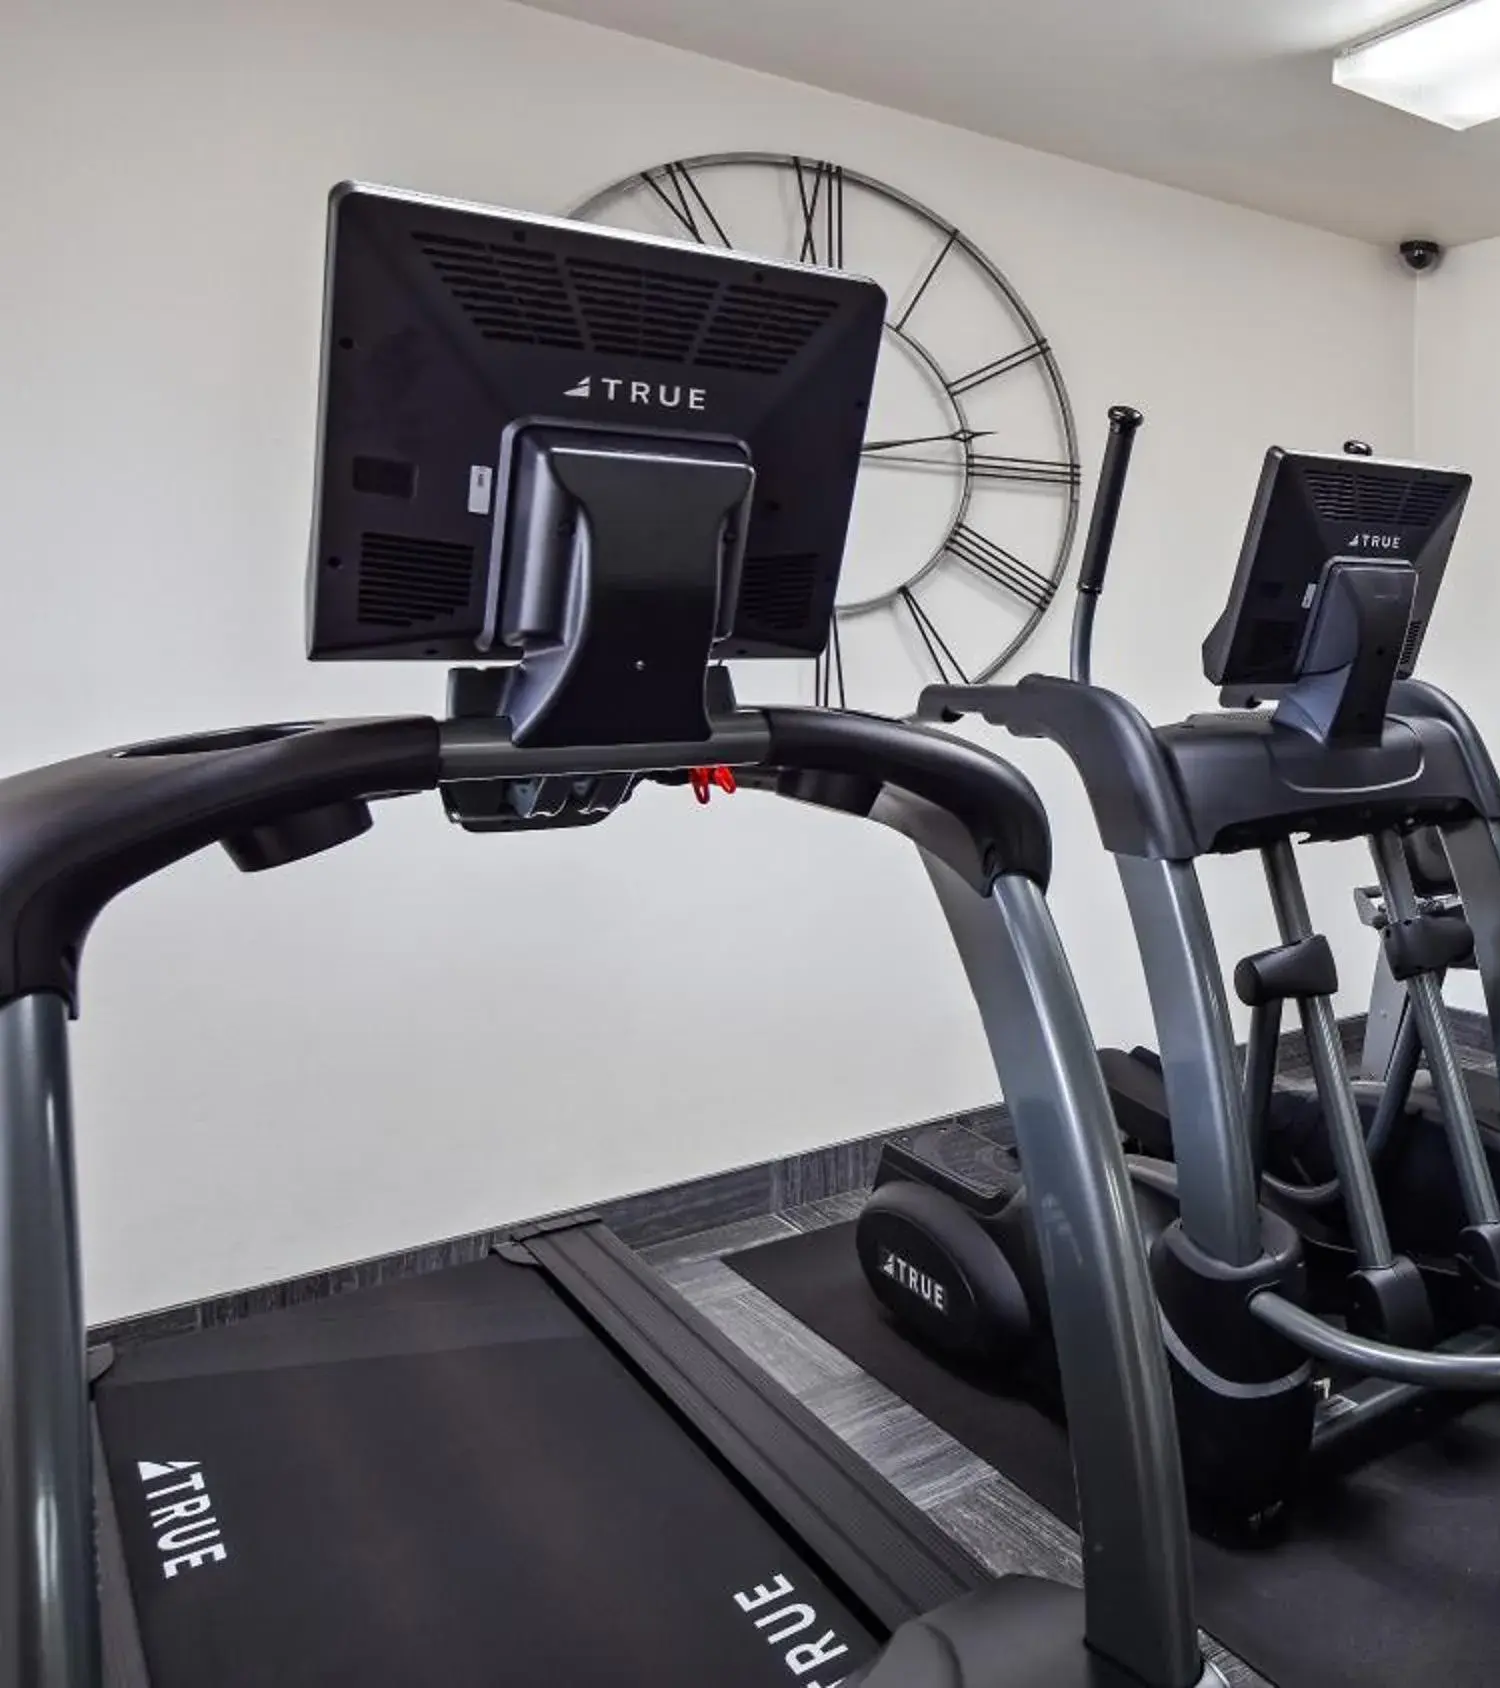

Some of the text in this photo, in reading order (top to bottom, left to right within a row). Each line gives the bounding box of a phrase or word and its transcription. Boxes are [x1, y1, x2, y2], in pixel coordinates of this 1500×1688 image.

[601, 377, 706, 411] TRUE
[1361, 533, 1402, 549] TRUE
[896, 1257, 944, 1311] TRUE
[145, 1471, 228, 1580] TRUE
